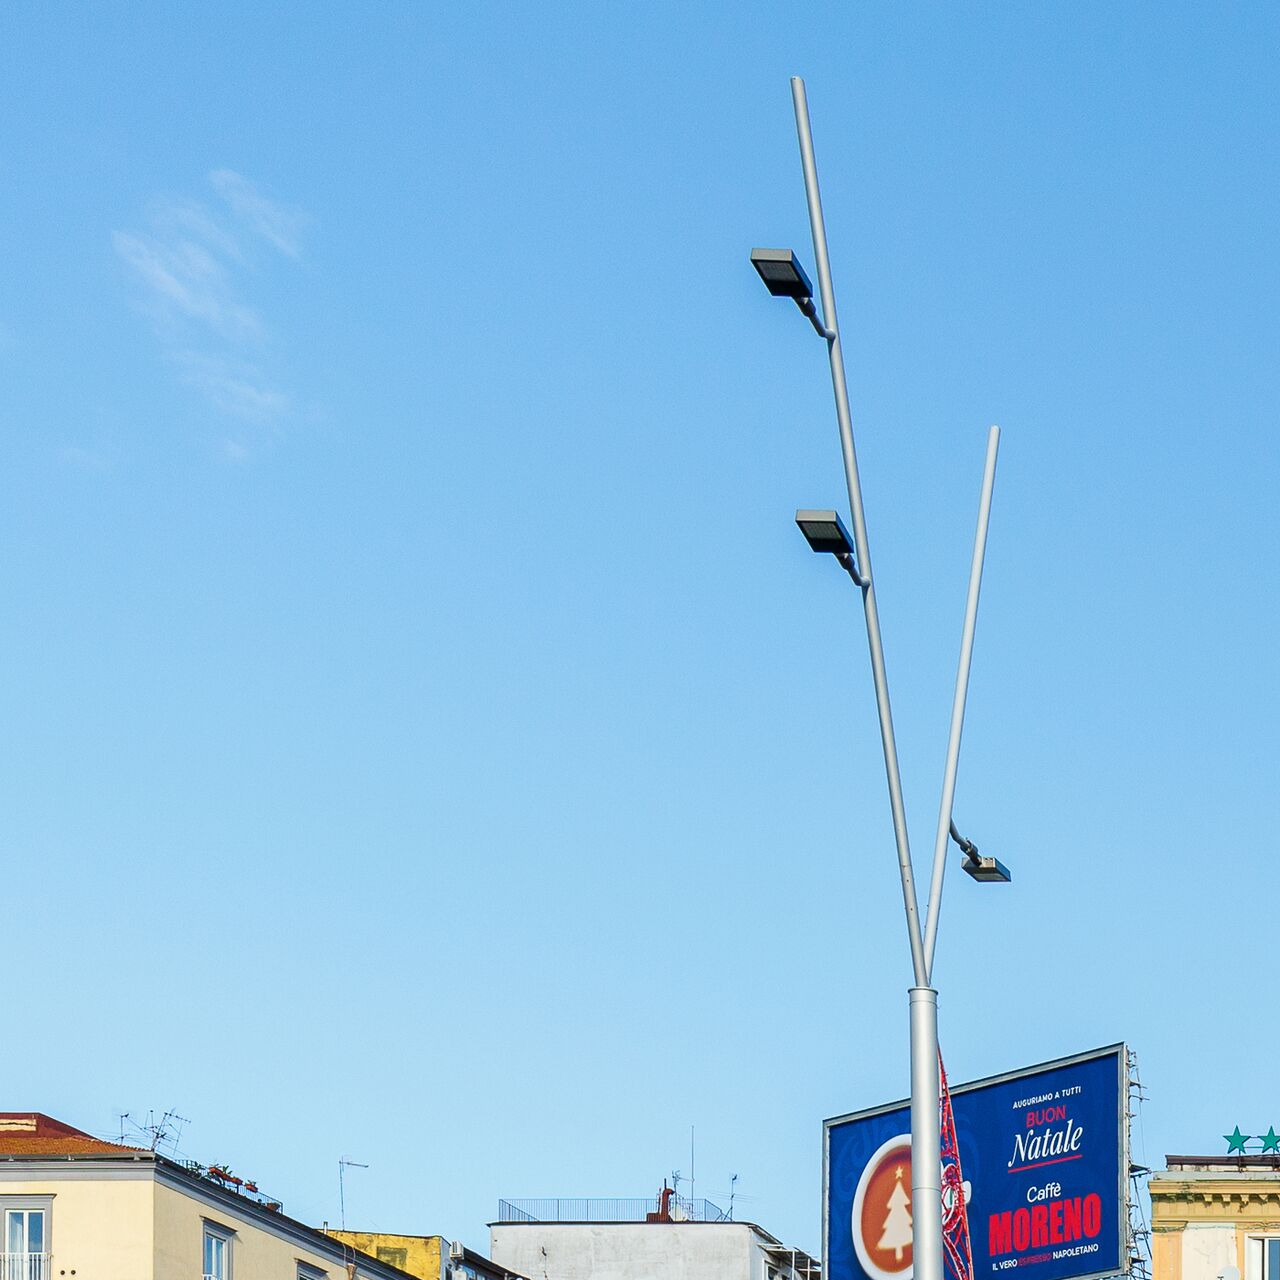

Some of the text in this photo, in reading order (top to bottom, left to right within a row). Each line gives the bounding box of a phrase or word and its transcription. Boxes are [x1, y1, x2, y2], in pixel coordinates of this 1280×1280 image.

[1012, 1086, 1082, 1109] AUGURIAMO A TUTTI
[1026, 1104, 1067, 1129] BUON
[1008, 1119, 1083, 1168] Natale
[1027, 1182, 1062, 1203] Caffè
[988, 1192, 1102, 1257] MORENO
[992, 1263, 999, 1271] IL
[999, 1259, 1018, 1269] VERO
[1052, 1243, 1099, 1260] NAPOLETANO
